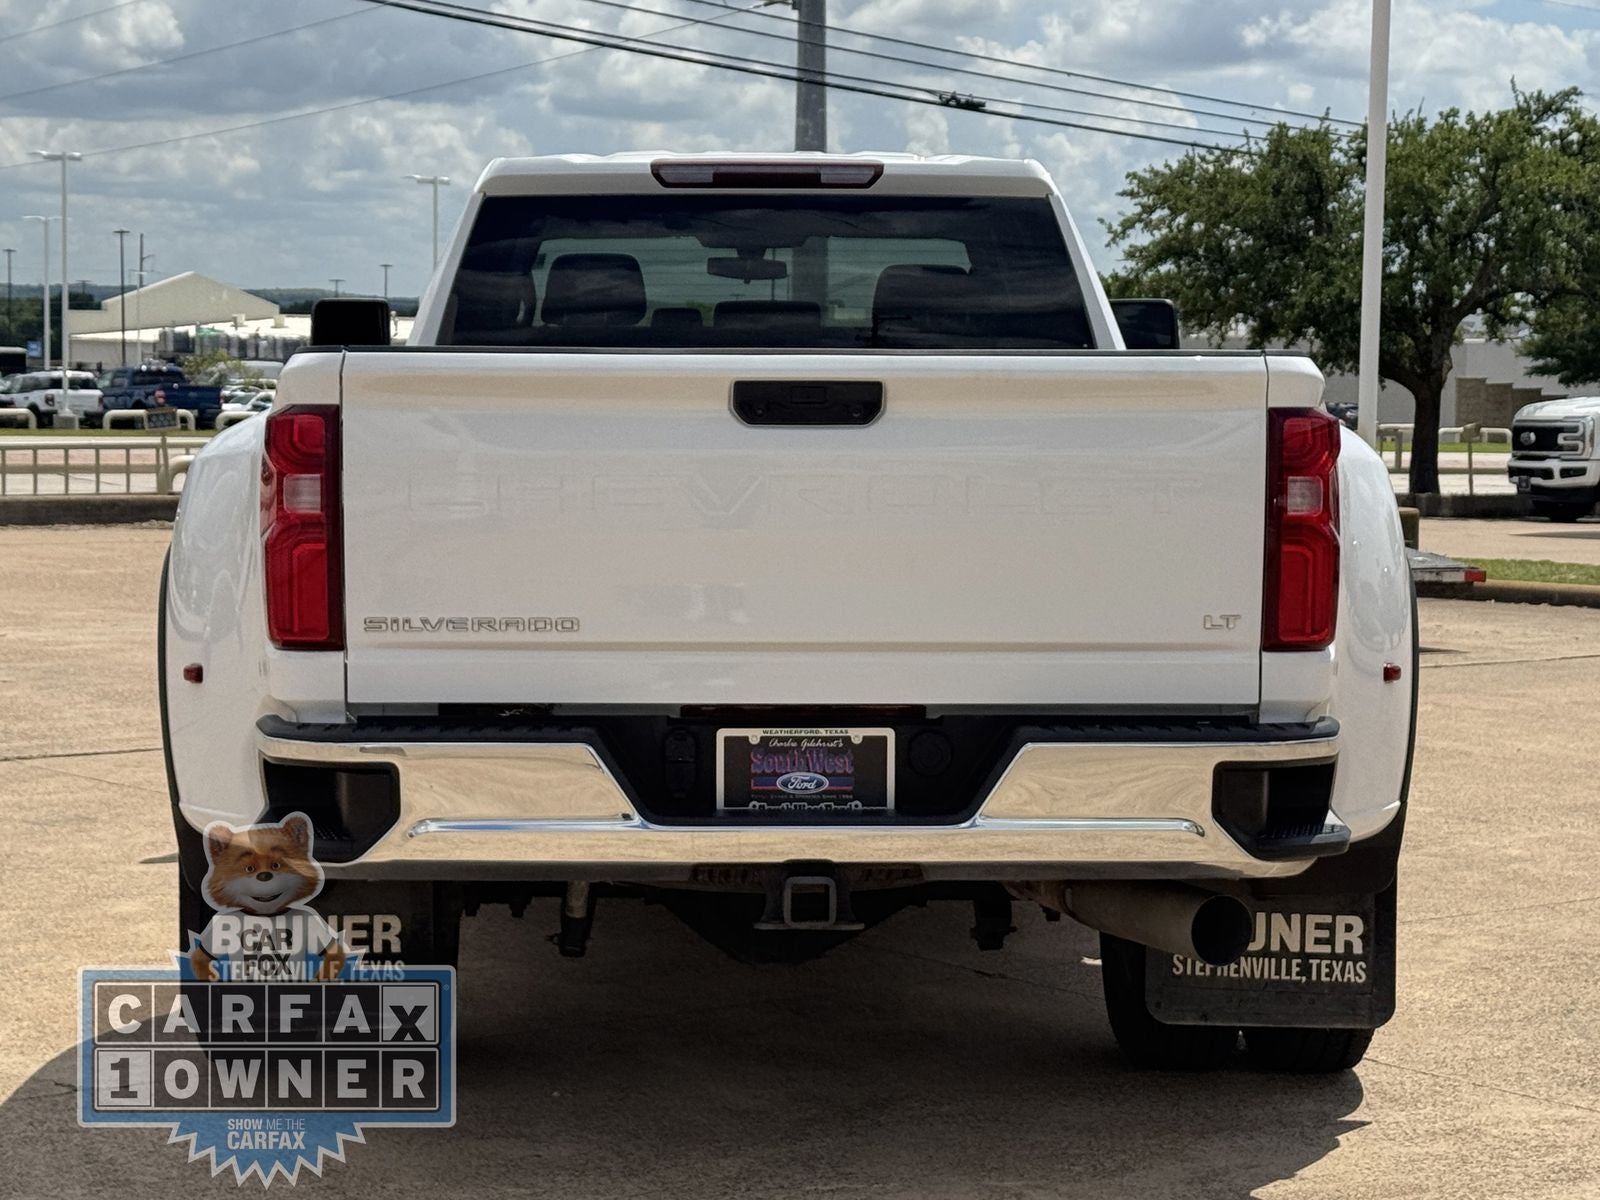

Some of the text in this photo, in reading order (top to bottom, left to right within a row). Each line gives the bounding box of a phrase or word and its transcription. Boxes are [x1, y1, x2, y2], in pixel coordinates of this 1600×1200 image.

[407, 472, 1203, 516] CHEVROLET
[363, 616, 580, 633] SILVERADO
[1203, 614, 1242, 630] LT
[787, 775, 818, 790] Ford
[211, 914, 402, 954] BRUNER
[1247, 911, 1365, 955] UNER
[350, 959, 406, 982] TEXAS
[1309, 958, 1367, 984] TEXAS
